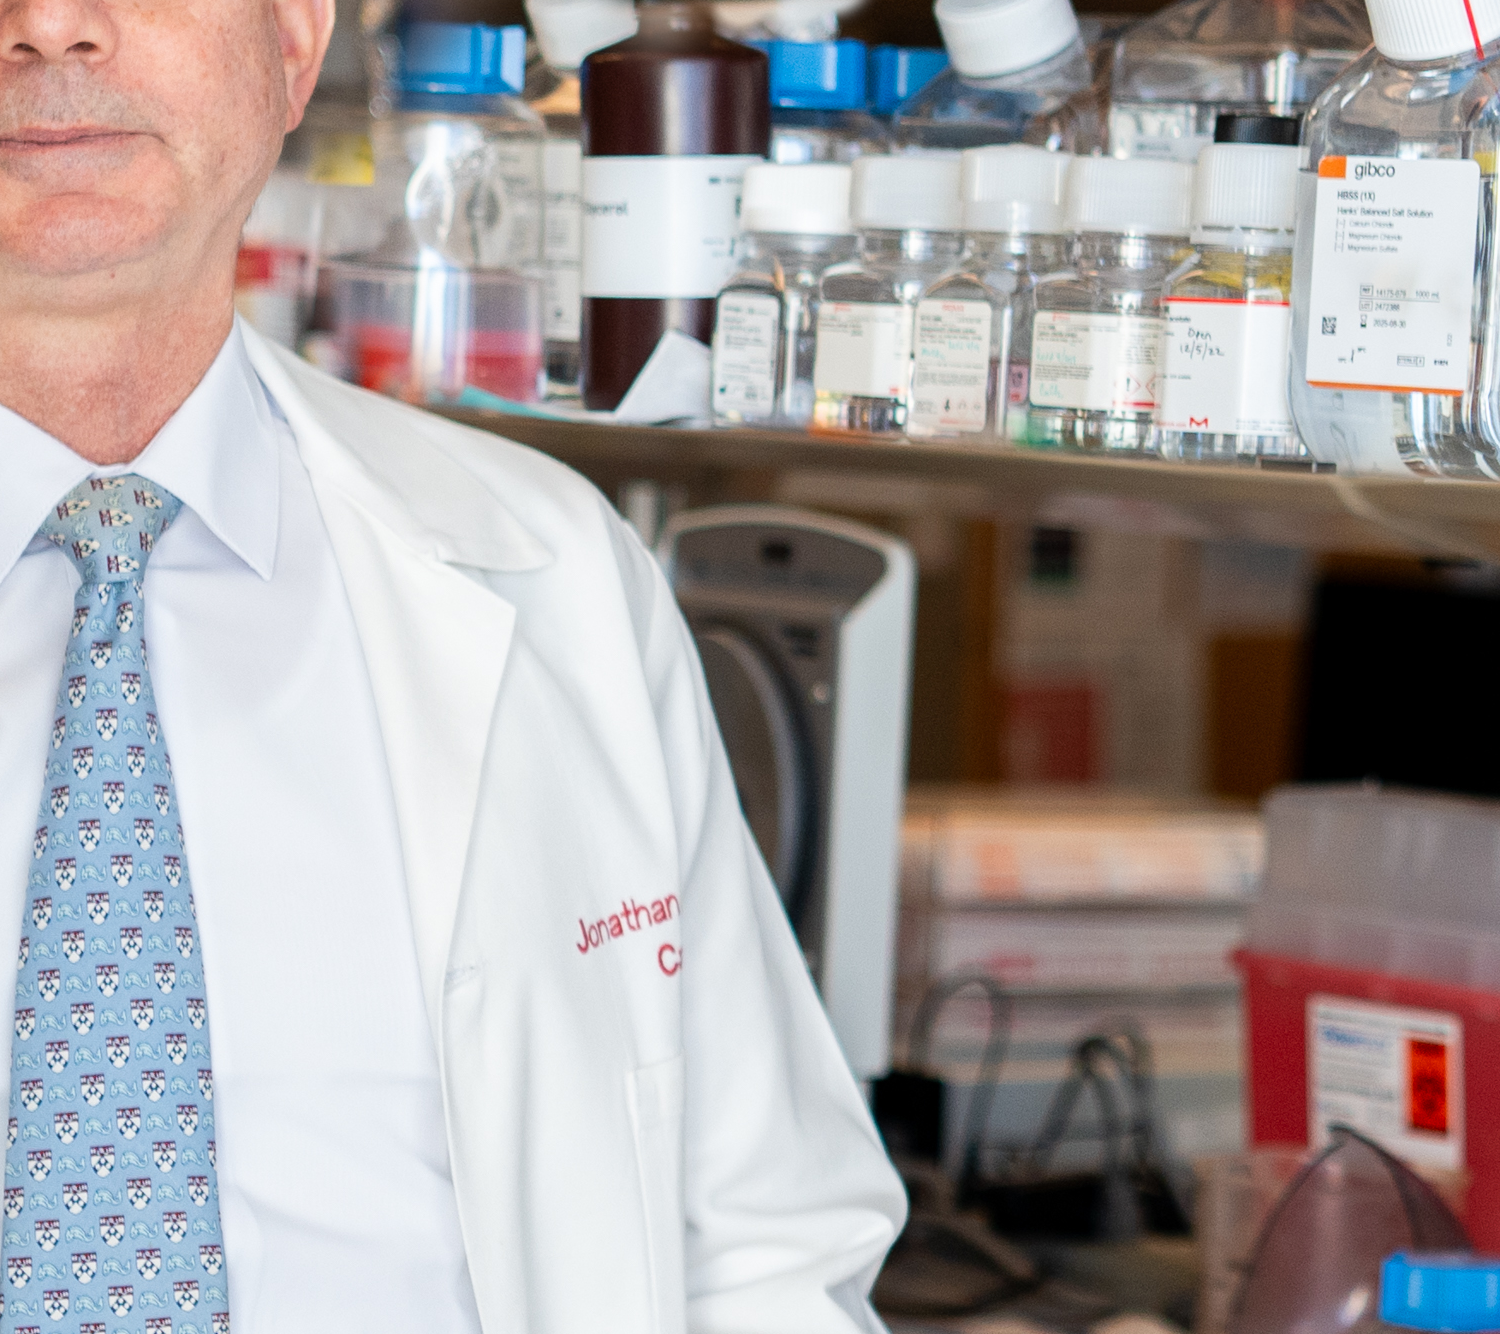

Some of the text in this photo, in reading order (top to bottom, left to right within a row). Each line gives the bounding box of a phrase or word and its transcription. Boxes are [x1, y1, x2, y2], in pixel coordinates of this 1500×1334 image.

[1355, 161, 1396, 179] gibco
[576, 894, 681, 954] Jonathan
[657, 943, 683, 977] C
